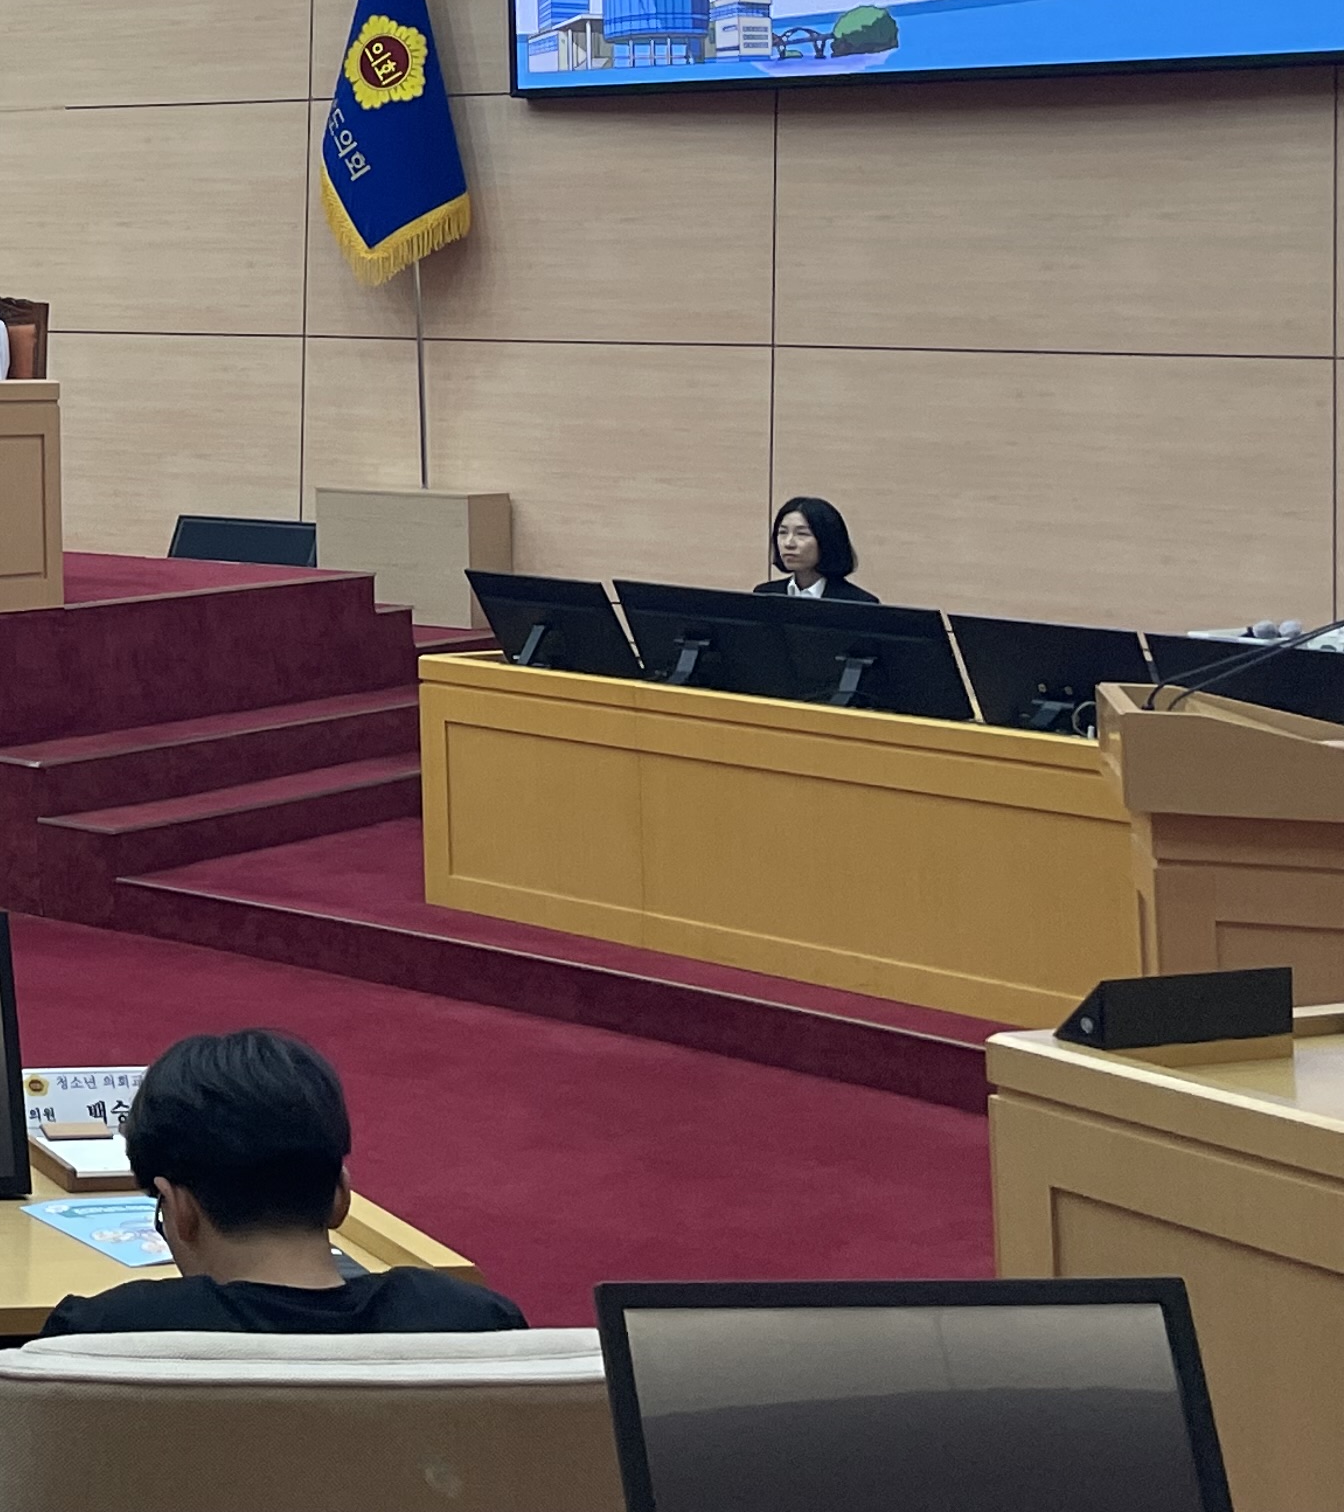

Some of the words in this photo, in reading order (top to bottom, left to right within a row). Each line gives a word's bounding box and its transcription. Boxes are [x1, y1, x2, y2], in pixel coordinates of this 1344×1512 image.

[364, 42, 403, 85] 의회
[328, 102, 371, 181] 도의회
[56, 1075, 97, 1090] 청소년
[103, 1074, 143, 1088] 의회교
[29, 1108, 56, 1122] 의원
[87, 1100, 131, 1125] 배승
